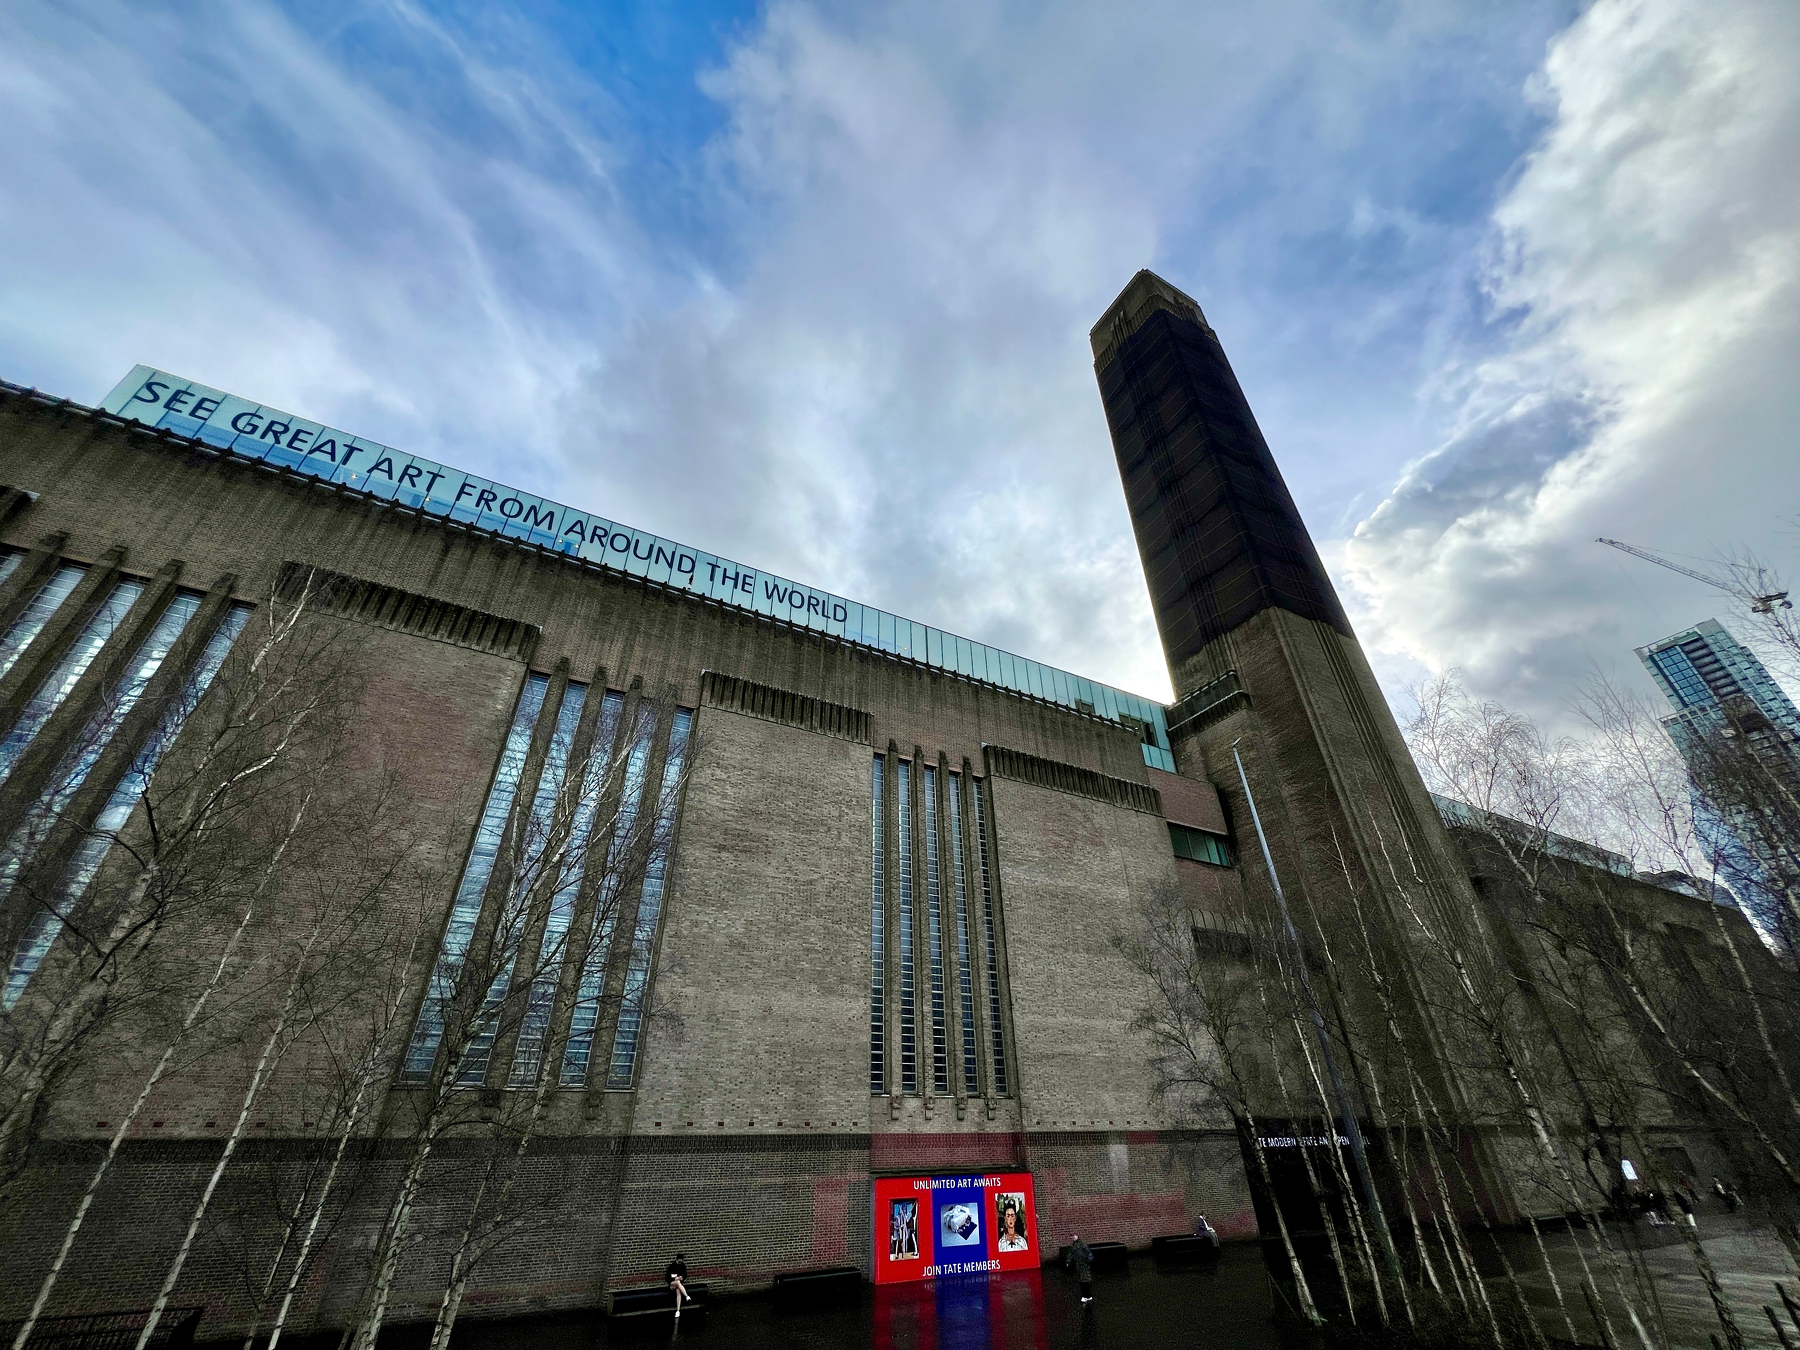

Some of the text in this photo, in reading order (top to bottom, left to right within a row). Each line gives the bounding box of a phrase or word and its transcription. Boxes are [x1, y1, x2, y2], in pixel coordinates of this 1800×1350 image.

[134, 381, 848, 623] SEE GREAT ART FROM AROUND THE WORLD
[1268, 1137, 1297, 1147] MODERN
[913, 1177, 1001, 1190] UNLIMITED ART AWAITS
[922, 1260, 1001, 1277] JOIN TATE MEMBERS
